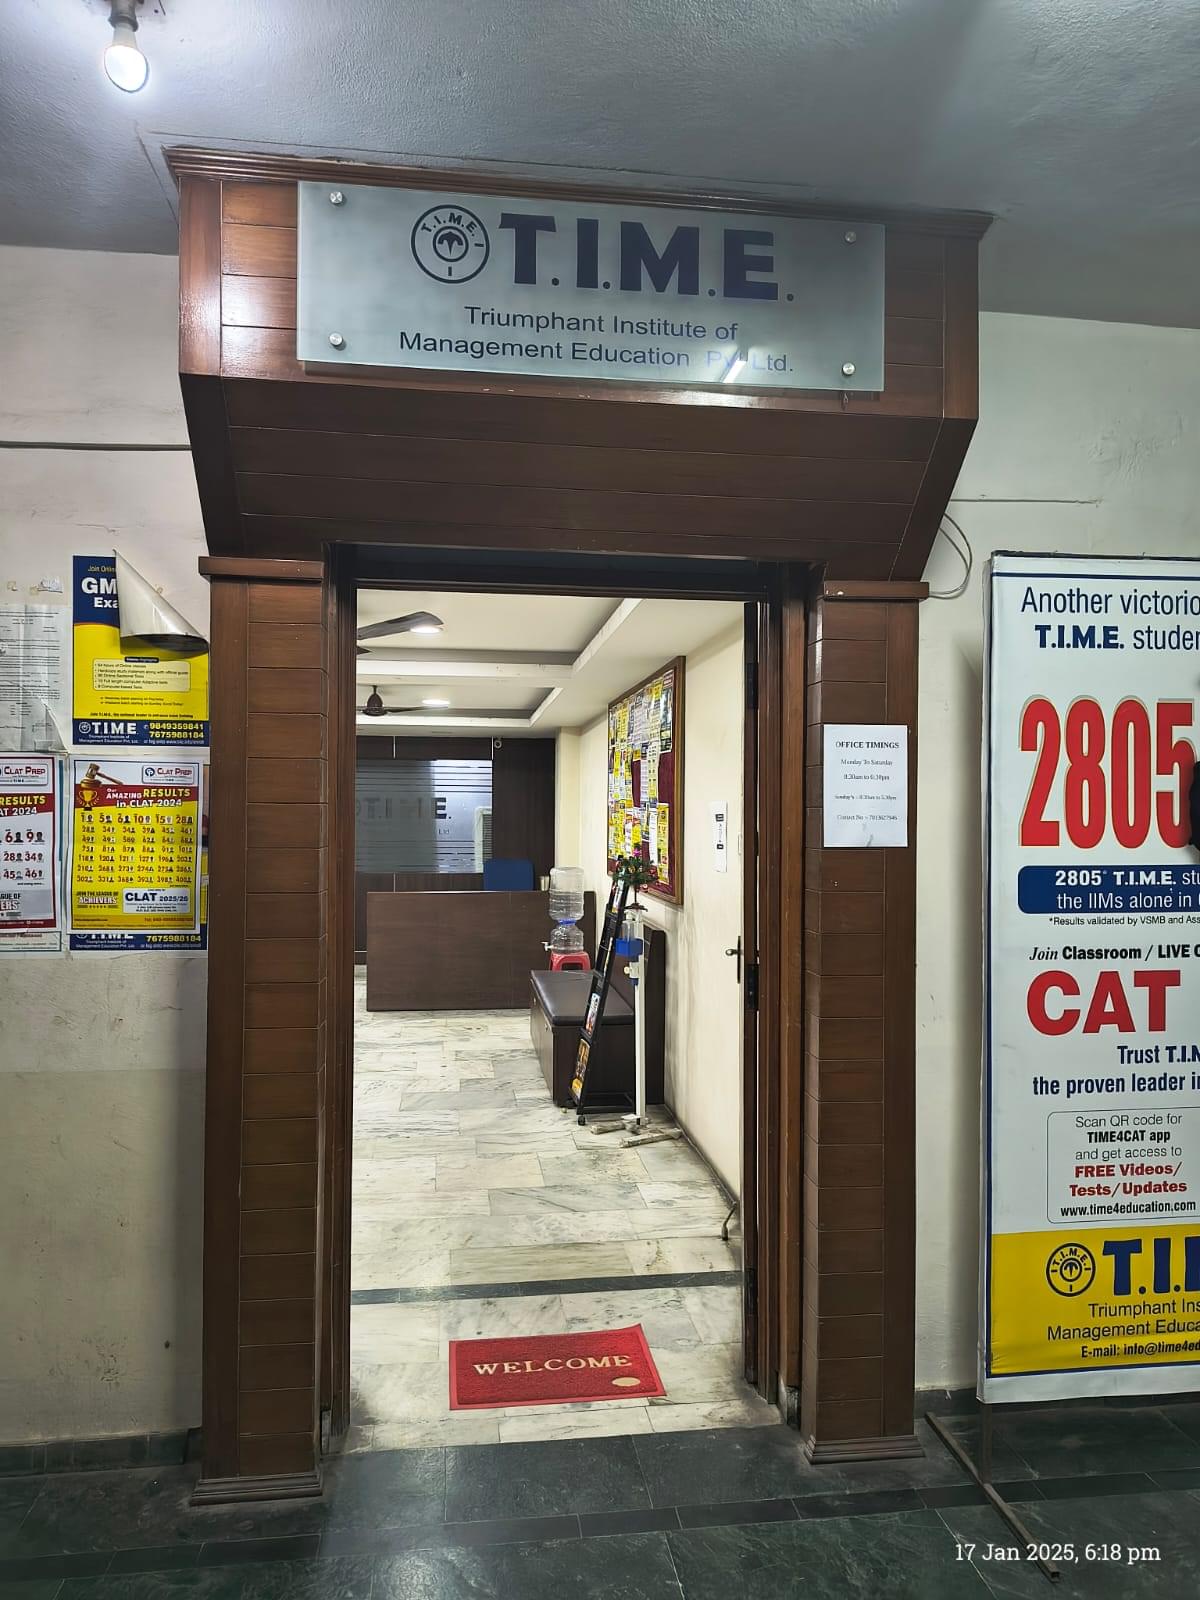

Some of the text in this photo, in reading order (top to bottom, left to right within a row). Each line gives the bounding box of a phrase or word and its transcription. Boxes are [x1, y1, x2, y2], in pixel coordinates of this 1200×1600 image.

[498, 212, 795, 302] T.I.M.E.
[464, 306, 738, 340] Triumphant Institute of
[400, 331, 563, 360] Management
[571, 342, 690, 367] Education
[752, 352, 794, 372] Ltd.
[1021, 587, 1200, 616] Another victorio
[1034, 624, 1125, 649] T.I.M.E.
[835, 741, 900, 749] OFFICE TIMINGS
[1018, 695, 1197, 850] 2805
[143, 788, 191, 798] RESULTS
[12, 807, 37, 816] 2024
[130, 800, 155, 808] CLAT
[4, 853, 36, 861] 28 34
[4, 870, 37, 879] 45 46
[1113, 870, 1177, 886] T.I.M.E.
[125, 892, 157, 902] CLAT
[1056, 893, 1082, 910] the
[1089, 892, 1124, 909] IIMs
[1129, 892, 1173, 909] alone
[1177, 892, 1192, 908] in
[1087, 916, 1124, 926] validated
[1127, 917, 1138, 926] by
[1140, 915, 1165, 924] VSMB
[1168, 915, 1184, 924] and
[1029, 946, 1058, 961] Join
[1062, 945, 1142, 960] Classroom
[1158, 943, 1190, 959] LIVE
[1026, 969, 1181, 1037] CAT
[1117, 1045, 1160, 1065] Trust
[1033, 1076, 1060, 1096] the
[1066, 1077, 1125, 1099] proven
[1131, 1072, 1186, 1092] leader
[1075, 1112, 1183, 1128] Scan QR code for
[1087, 1130, 1171, 1144] TIME4CAT app
[1075, 1146, 1182, 1162] and get access to
[1075, 1161, 1183, 1178] FREE Videos/
[1060, 1200, 1197, 1217] www.time4education.com
[1088, 1299, 1177, 1318] Triumphant
[1047, 1320, 1151, 1341] Management
[1081, 1343, 1120, 1358] E-mail:
[472, 1354, 633, 1376] WELCOME
